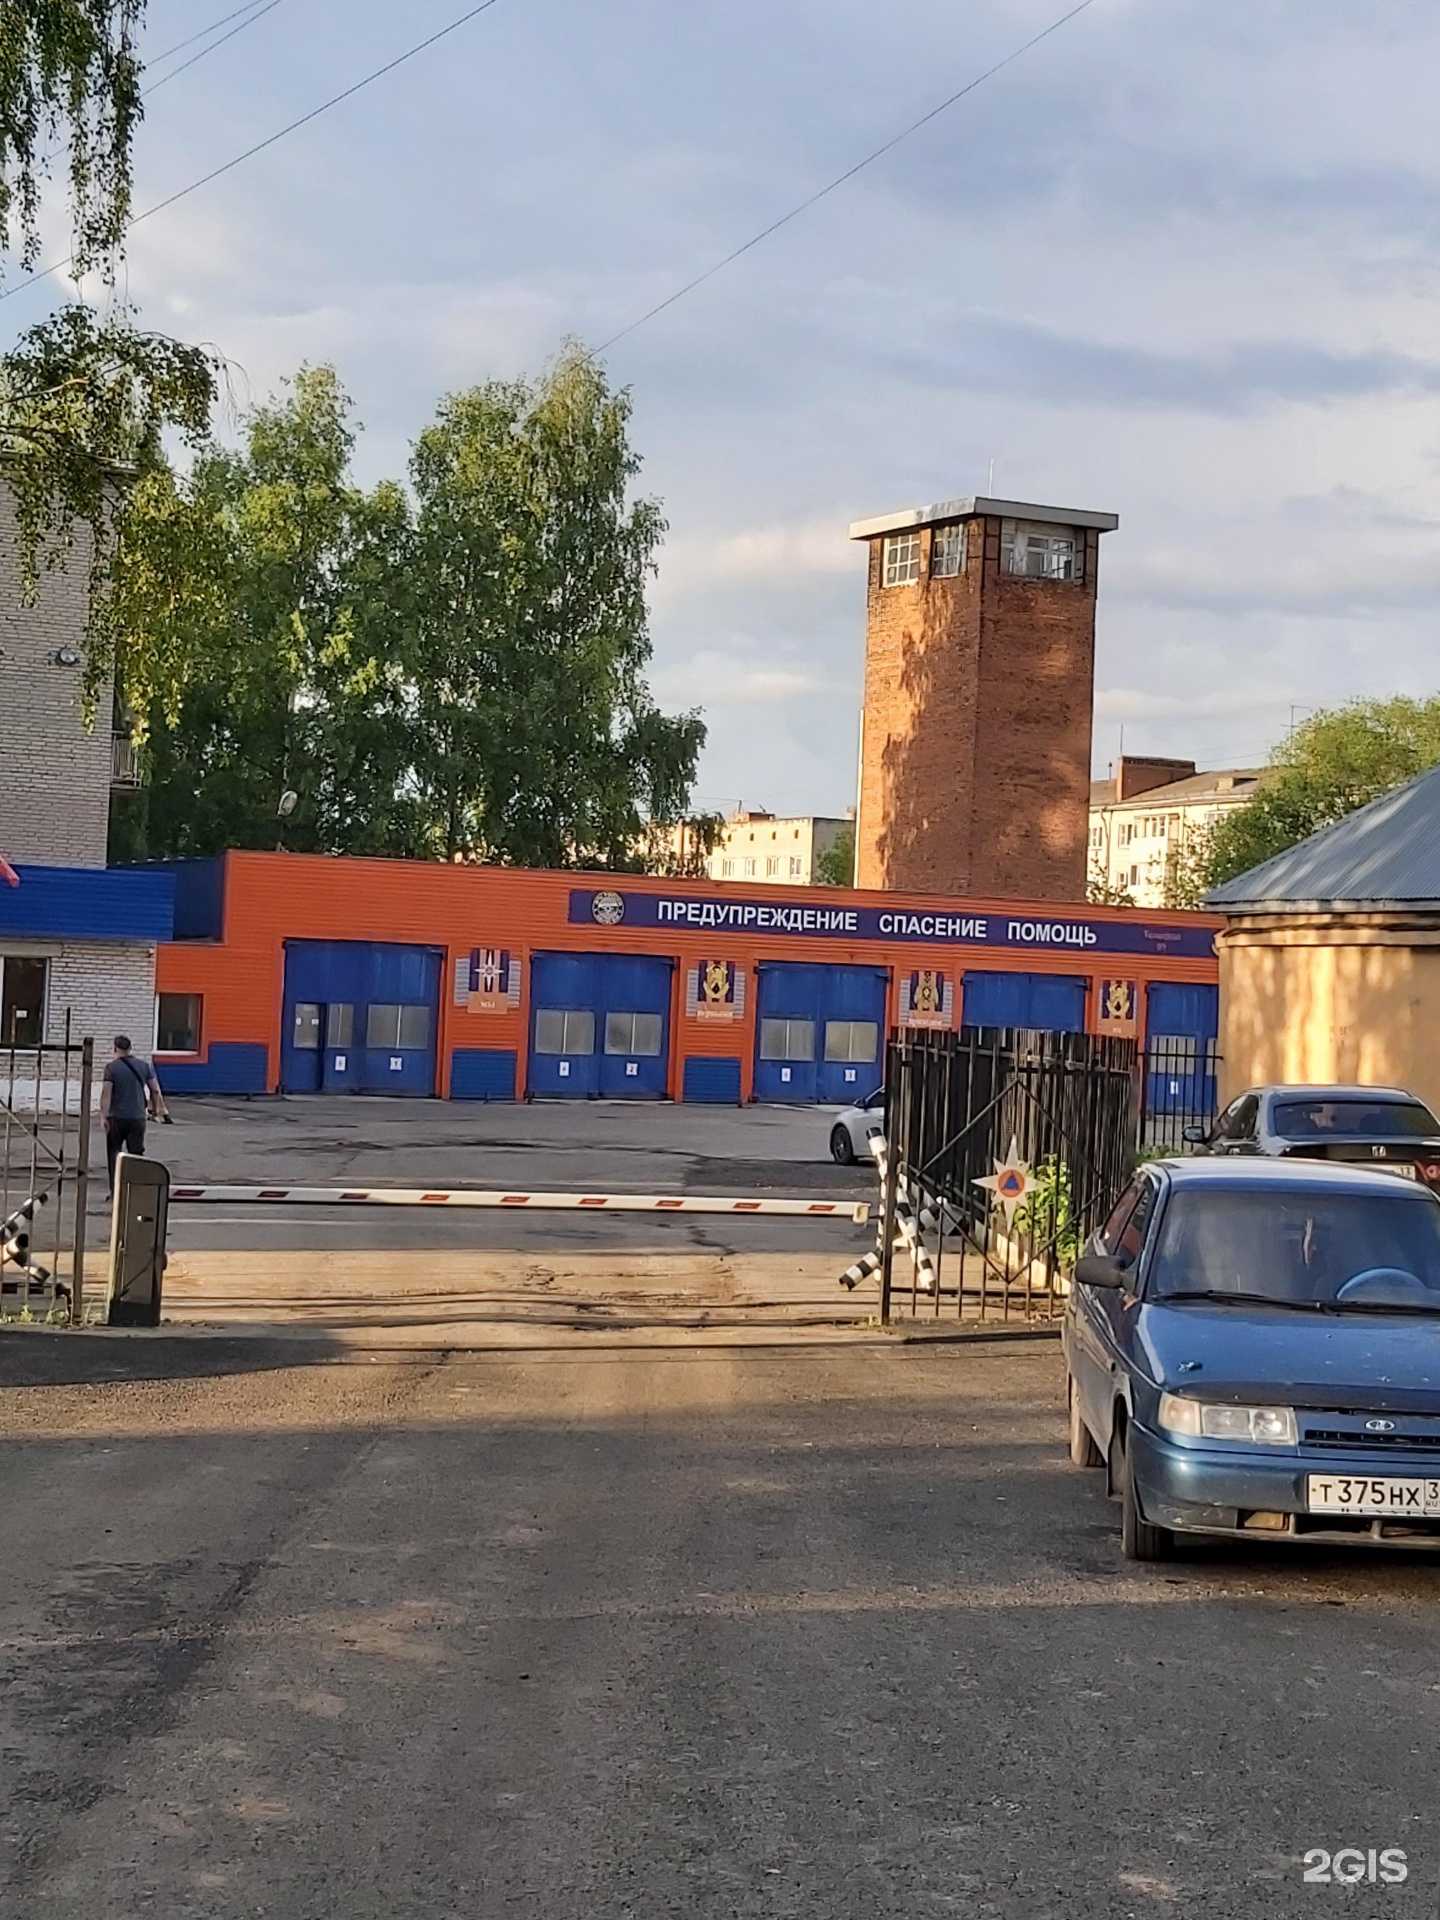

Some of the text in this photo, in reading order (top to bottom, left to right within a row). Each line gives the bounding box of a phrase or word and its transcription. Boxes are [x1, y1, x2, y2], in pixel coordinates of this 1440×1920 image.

[657, 901, 1097, 946] ПРЕДУПРЕЖДЕНИЕ СПАСЕНИЕ ПОМОЩЬ
